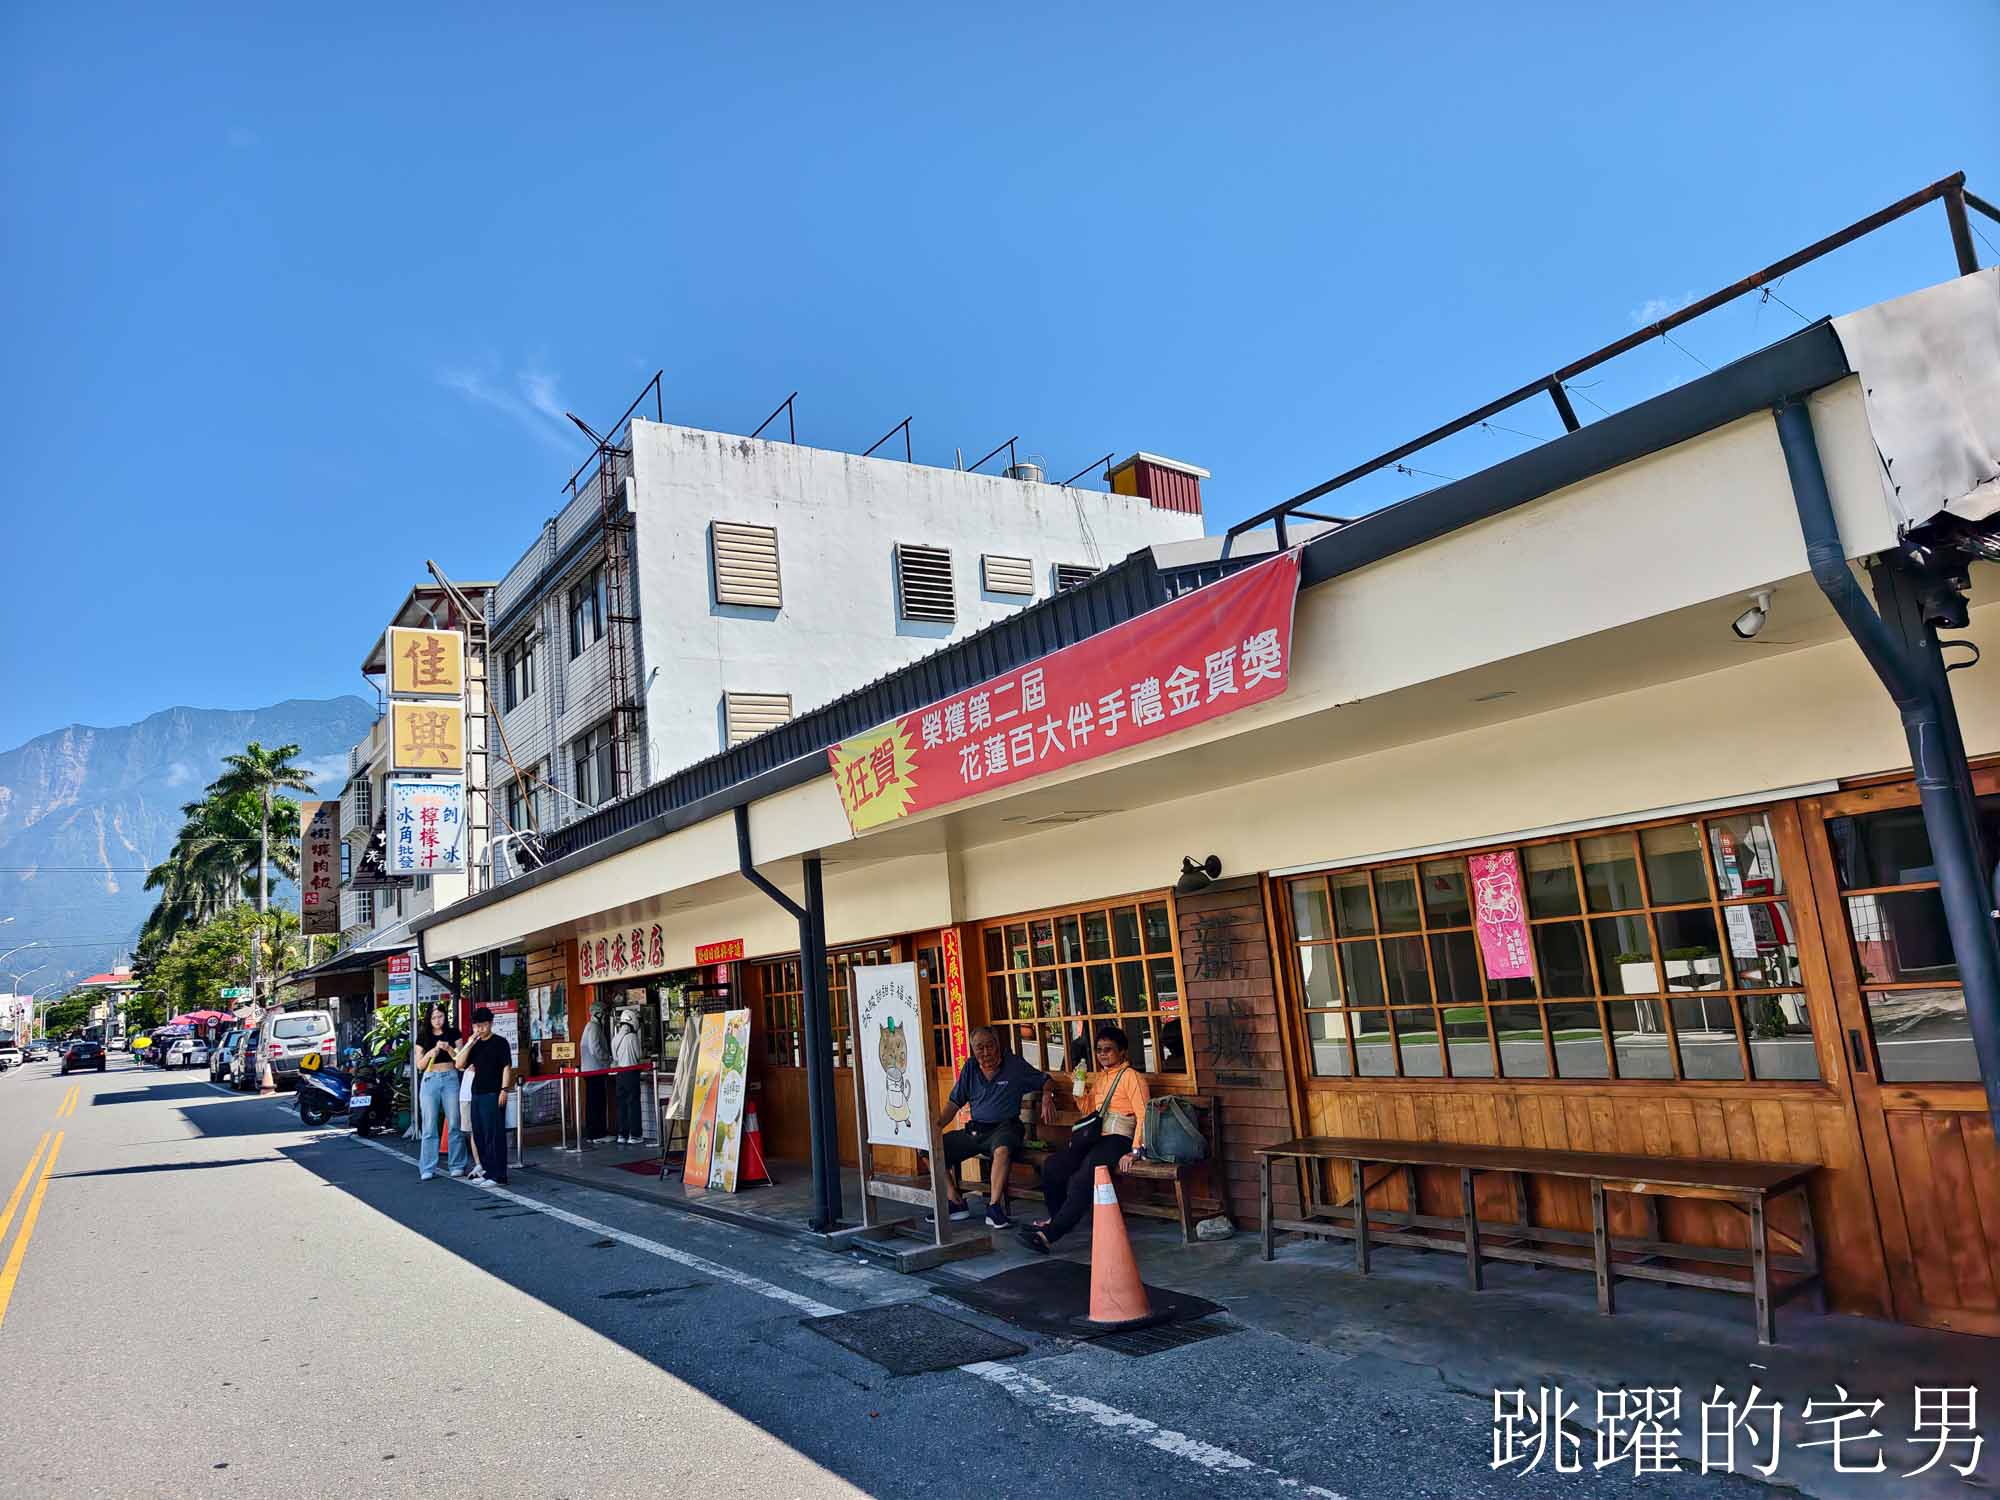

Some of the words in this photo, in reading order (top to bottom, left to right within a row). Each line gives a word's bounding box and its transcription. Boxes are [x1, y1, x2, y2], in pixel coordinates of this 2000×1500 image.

[921, 667, 1046, 750] 榮獲第二屆
[844, 737, 900, 813] 狂賀
[419, 806, 441, 869] 檸檬汁
